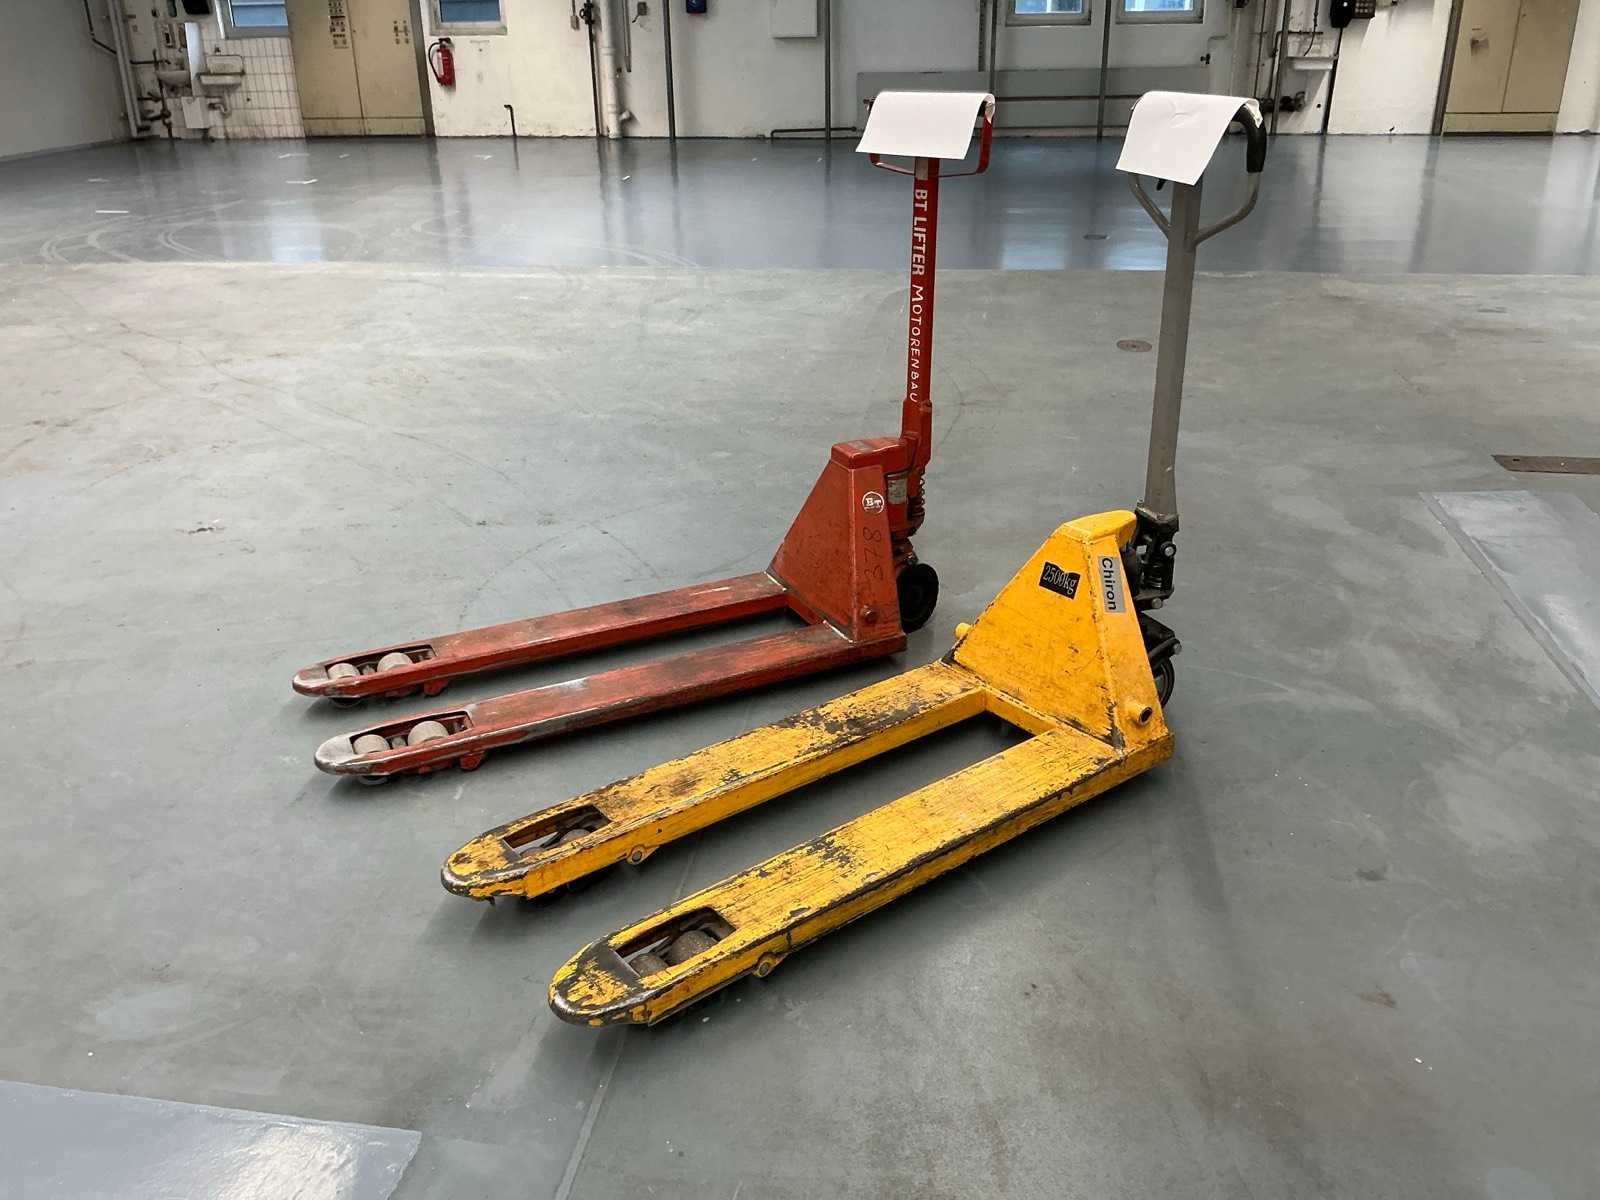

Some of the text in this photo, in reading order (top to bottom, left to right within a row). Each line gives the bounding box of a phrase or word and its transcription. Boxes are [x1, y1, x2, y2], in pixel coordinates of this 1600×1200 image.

[909, 189, 928, 404] BT LIFTER MOTORENBAU
[1042, 564, 1078, 595] 2500kg
[1101, 557, 1118, 611] Chiron
